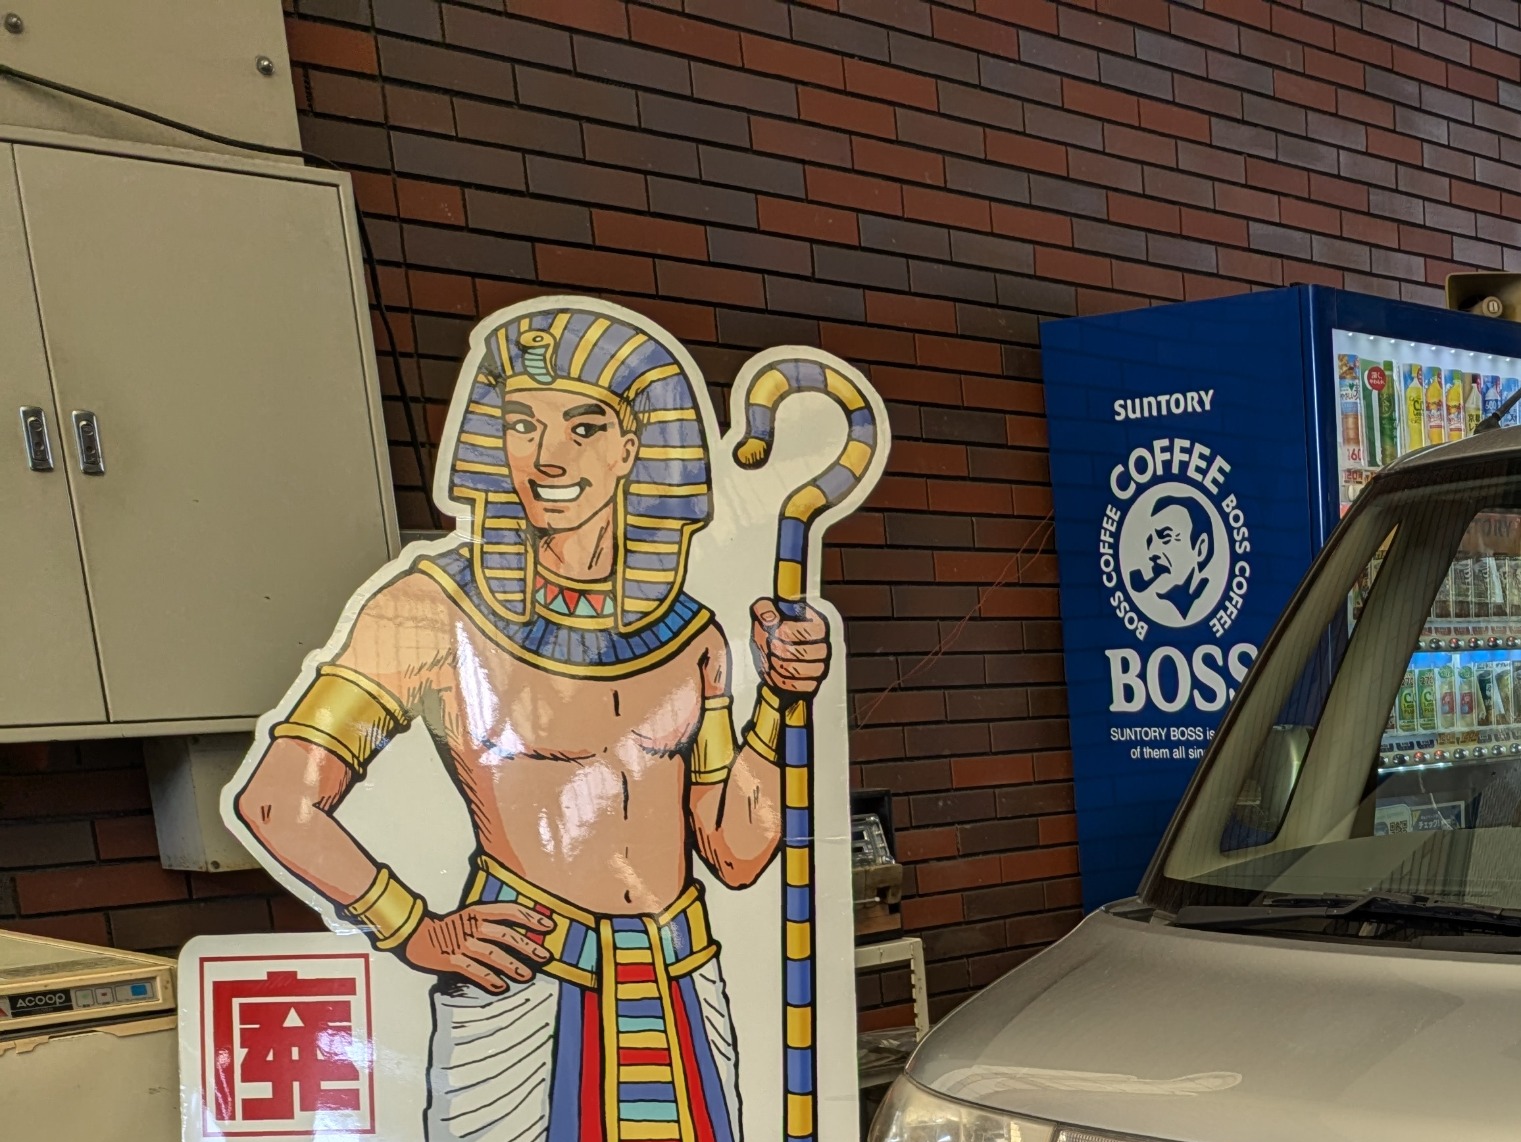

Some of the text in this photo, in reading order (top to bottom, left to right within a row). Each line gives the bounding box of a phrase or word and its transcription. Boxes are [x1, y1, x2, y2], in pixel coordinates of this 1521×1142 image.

[1113, 389, 1214, 421] SUNTORY
[1109, 438, 1231, 500] COFFEE
[1099, 504, 1149, 641] BOSS COFFEE
[1209, 493, 1251, 638] BOSS COFFEE
[1105, 642, 1258, 712] BOSS
[1110, 727, 1216, 741] SUNTORY BOSS is
[1130, 745, 1206, 759] of them all sin
